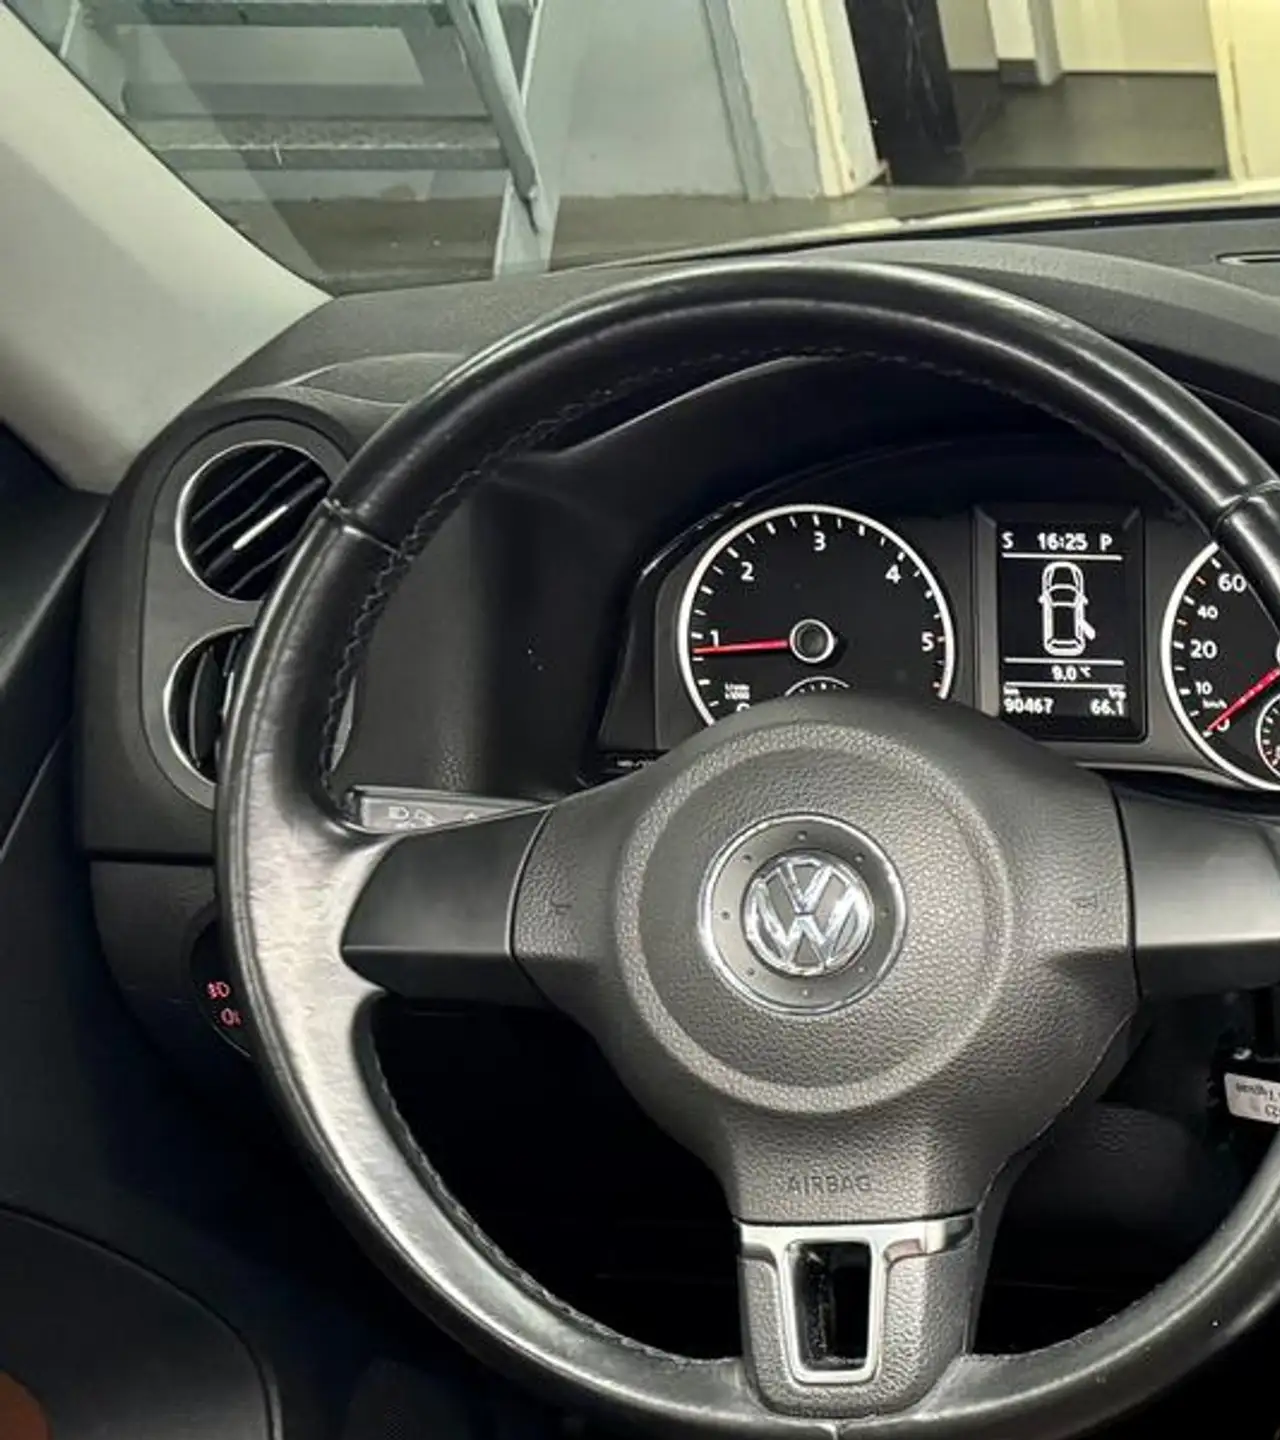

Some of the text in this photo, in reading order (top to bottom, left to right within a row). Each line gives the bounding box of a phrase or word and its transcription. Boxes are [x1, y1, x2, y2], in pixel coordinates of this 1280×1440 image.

[813, 531, 827, 551] 3
[1002, 532, 1113, 552] S 16:25 P
[740, 561, 755, 581] 2
[885, 564, 902, 585] 4
[1217, 573, 1247, 593] 60
[1197, 604, 1219, 620] 40
[920, 632, 934, 652] 5
[1189, 640, 1218, 660] 20
[1195, 681, 1213, 696] 10
[1003, 697, 1126, 716] 90467 66.1
[786, 1174, 873, 1194] AIRBAG
